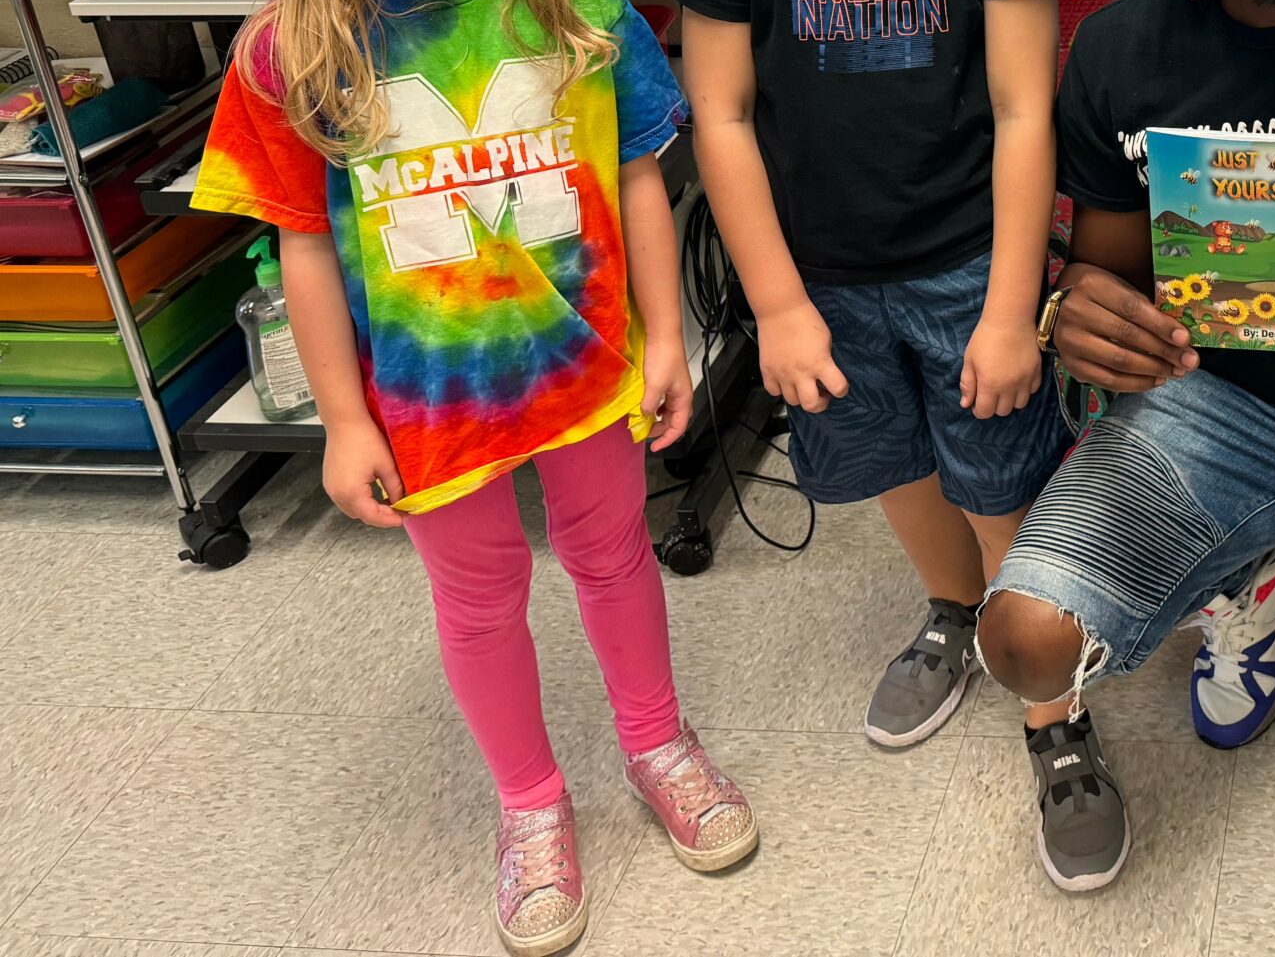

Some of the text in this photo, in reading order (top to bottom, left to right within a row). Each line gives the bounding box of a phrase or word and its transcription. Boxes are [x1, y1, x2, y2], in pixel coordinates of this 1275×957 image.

[1213, 150, 1257, 170] JUST
[1243, 328, 1259, 339] By:
[925, 630, 946, 645] NIKE
[1053, 753, 1081, 770] NIKE
